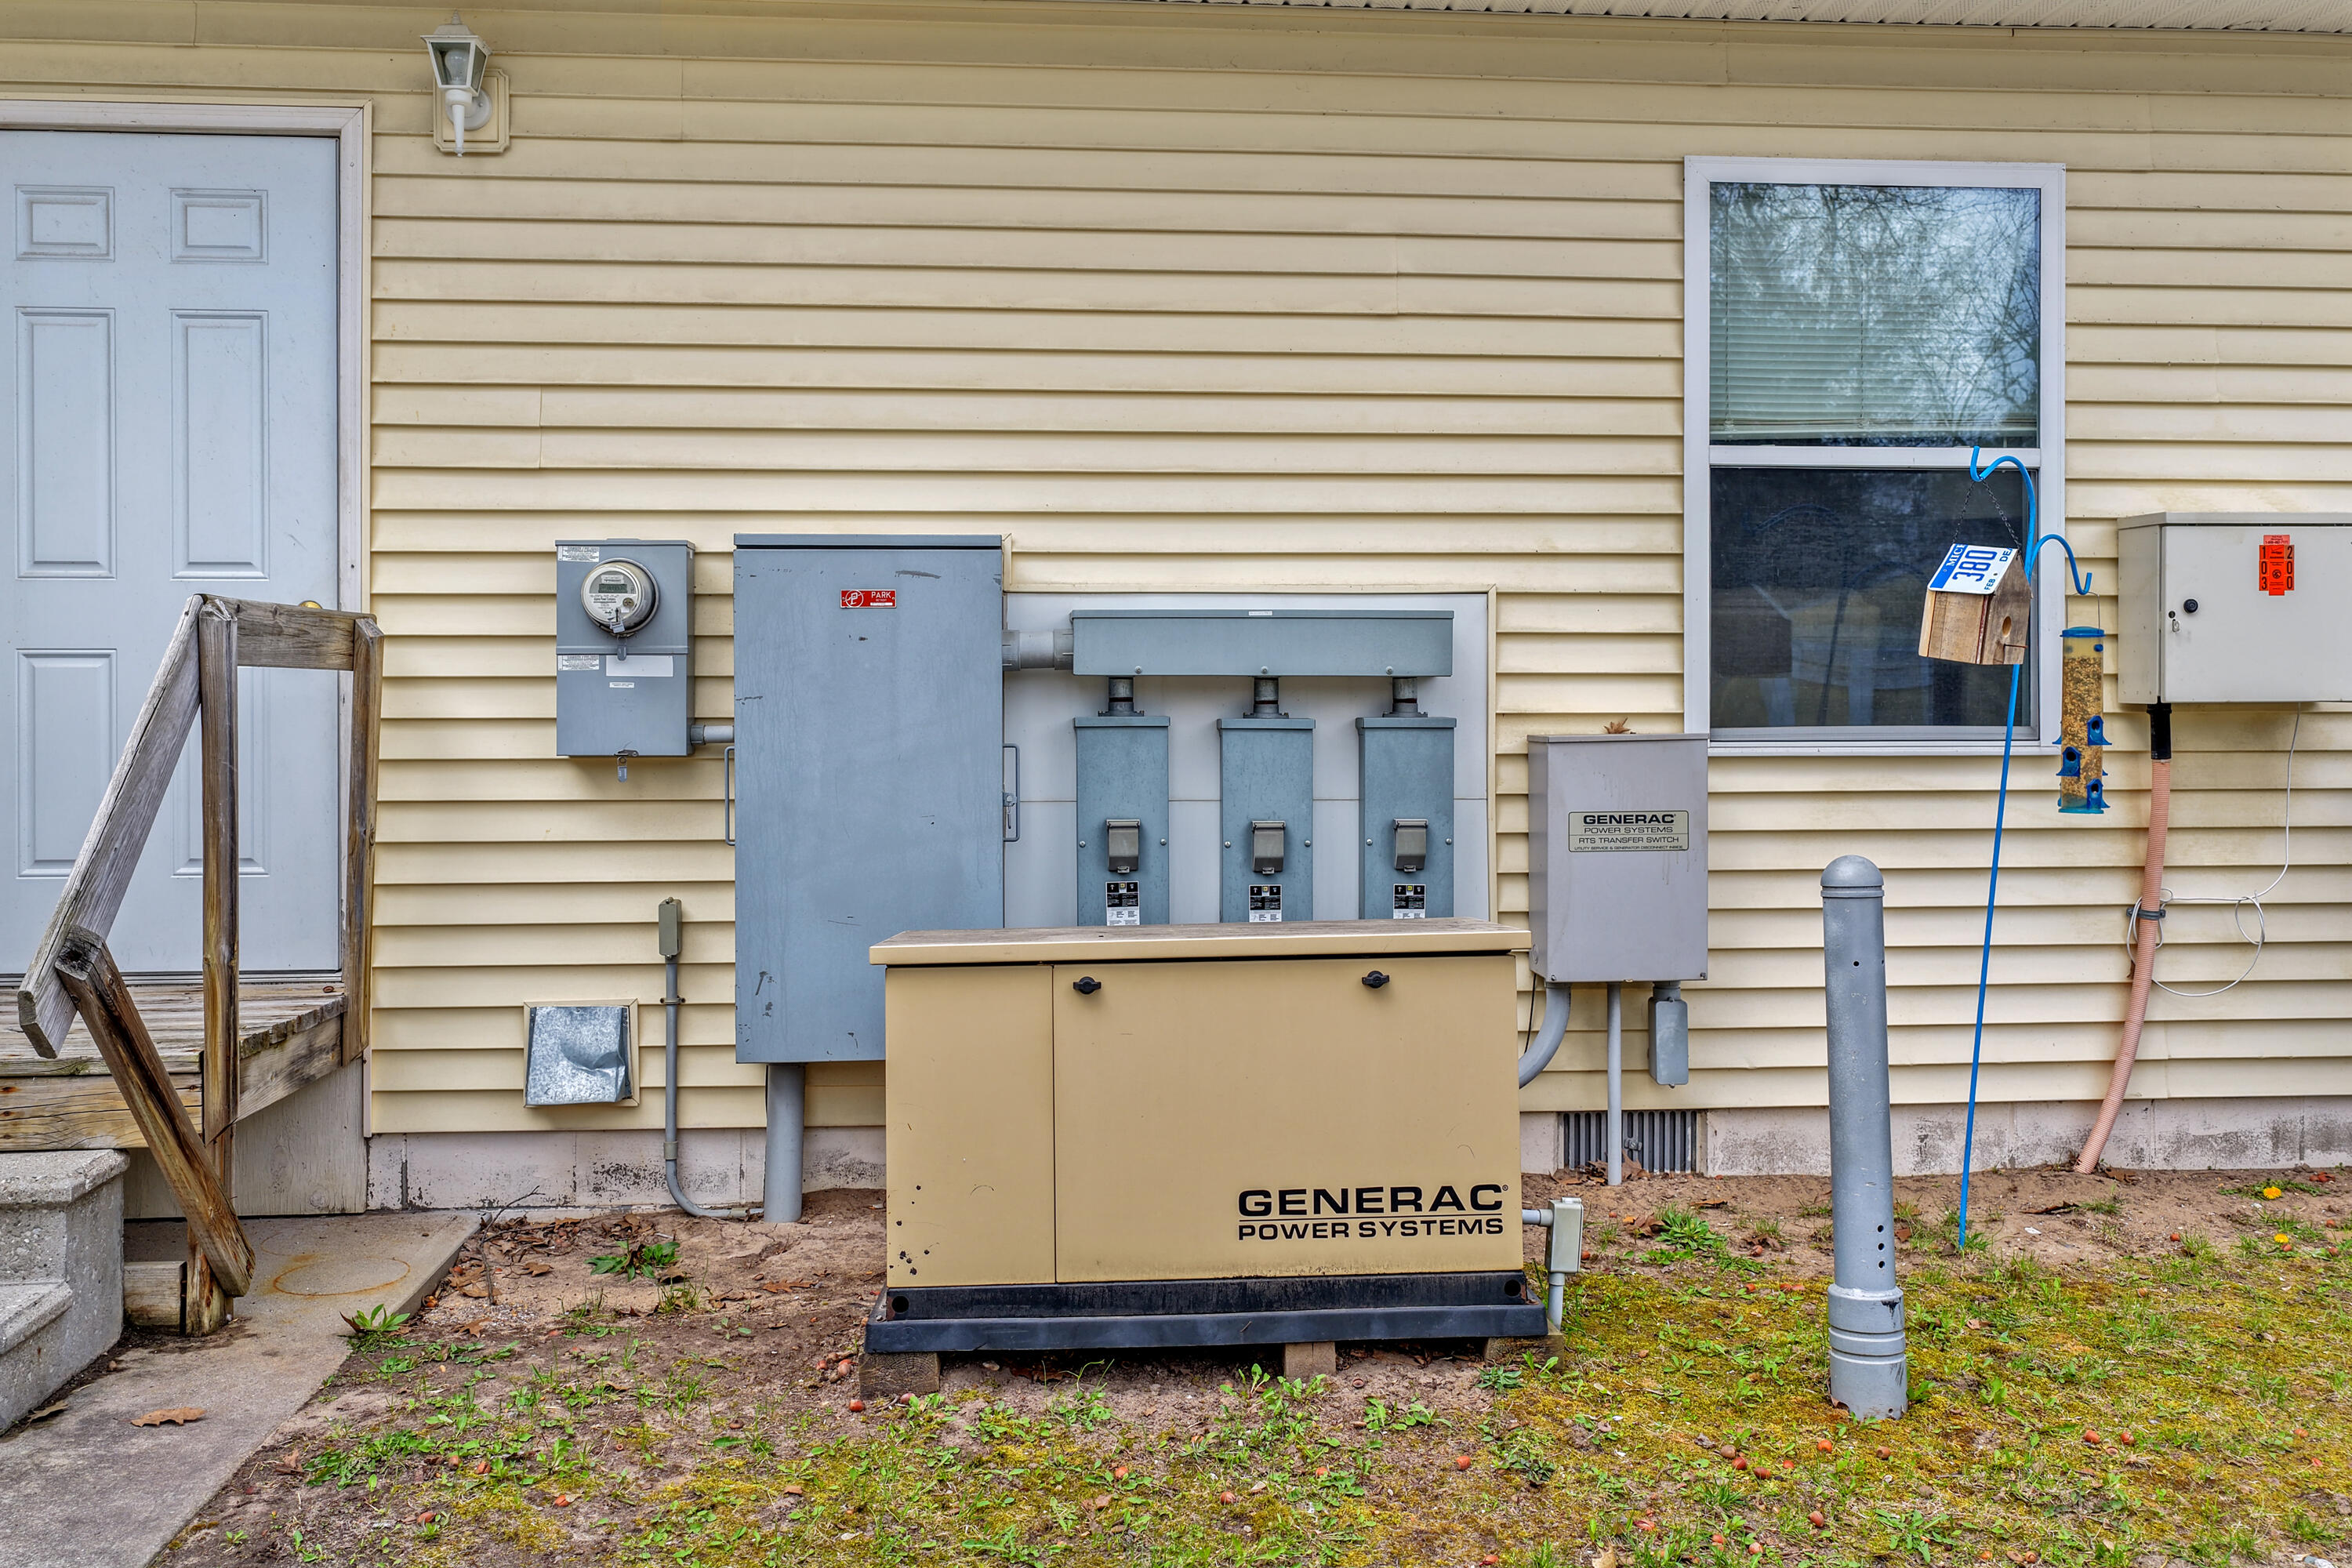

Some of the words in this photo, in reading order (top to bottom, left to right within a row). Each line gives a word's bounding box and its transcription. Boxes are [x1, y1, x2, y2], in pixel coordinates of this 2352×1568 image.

[1952, 550, 1998, 582] 380
[1984, 579, 1996, 590] FEB
[1583, 814, 1675, 824] GENERAC
[1238, 1222, 1350, 1241] POWER
[1358, 1218, 1504, 1239] SYSTEMS
